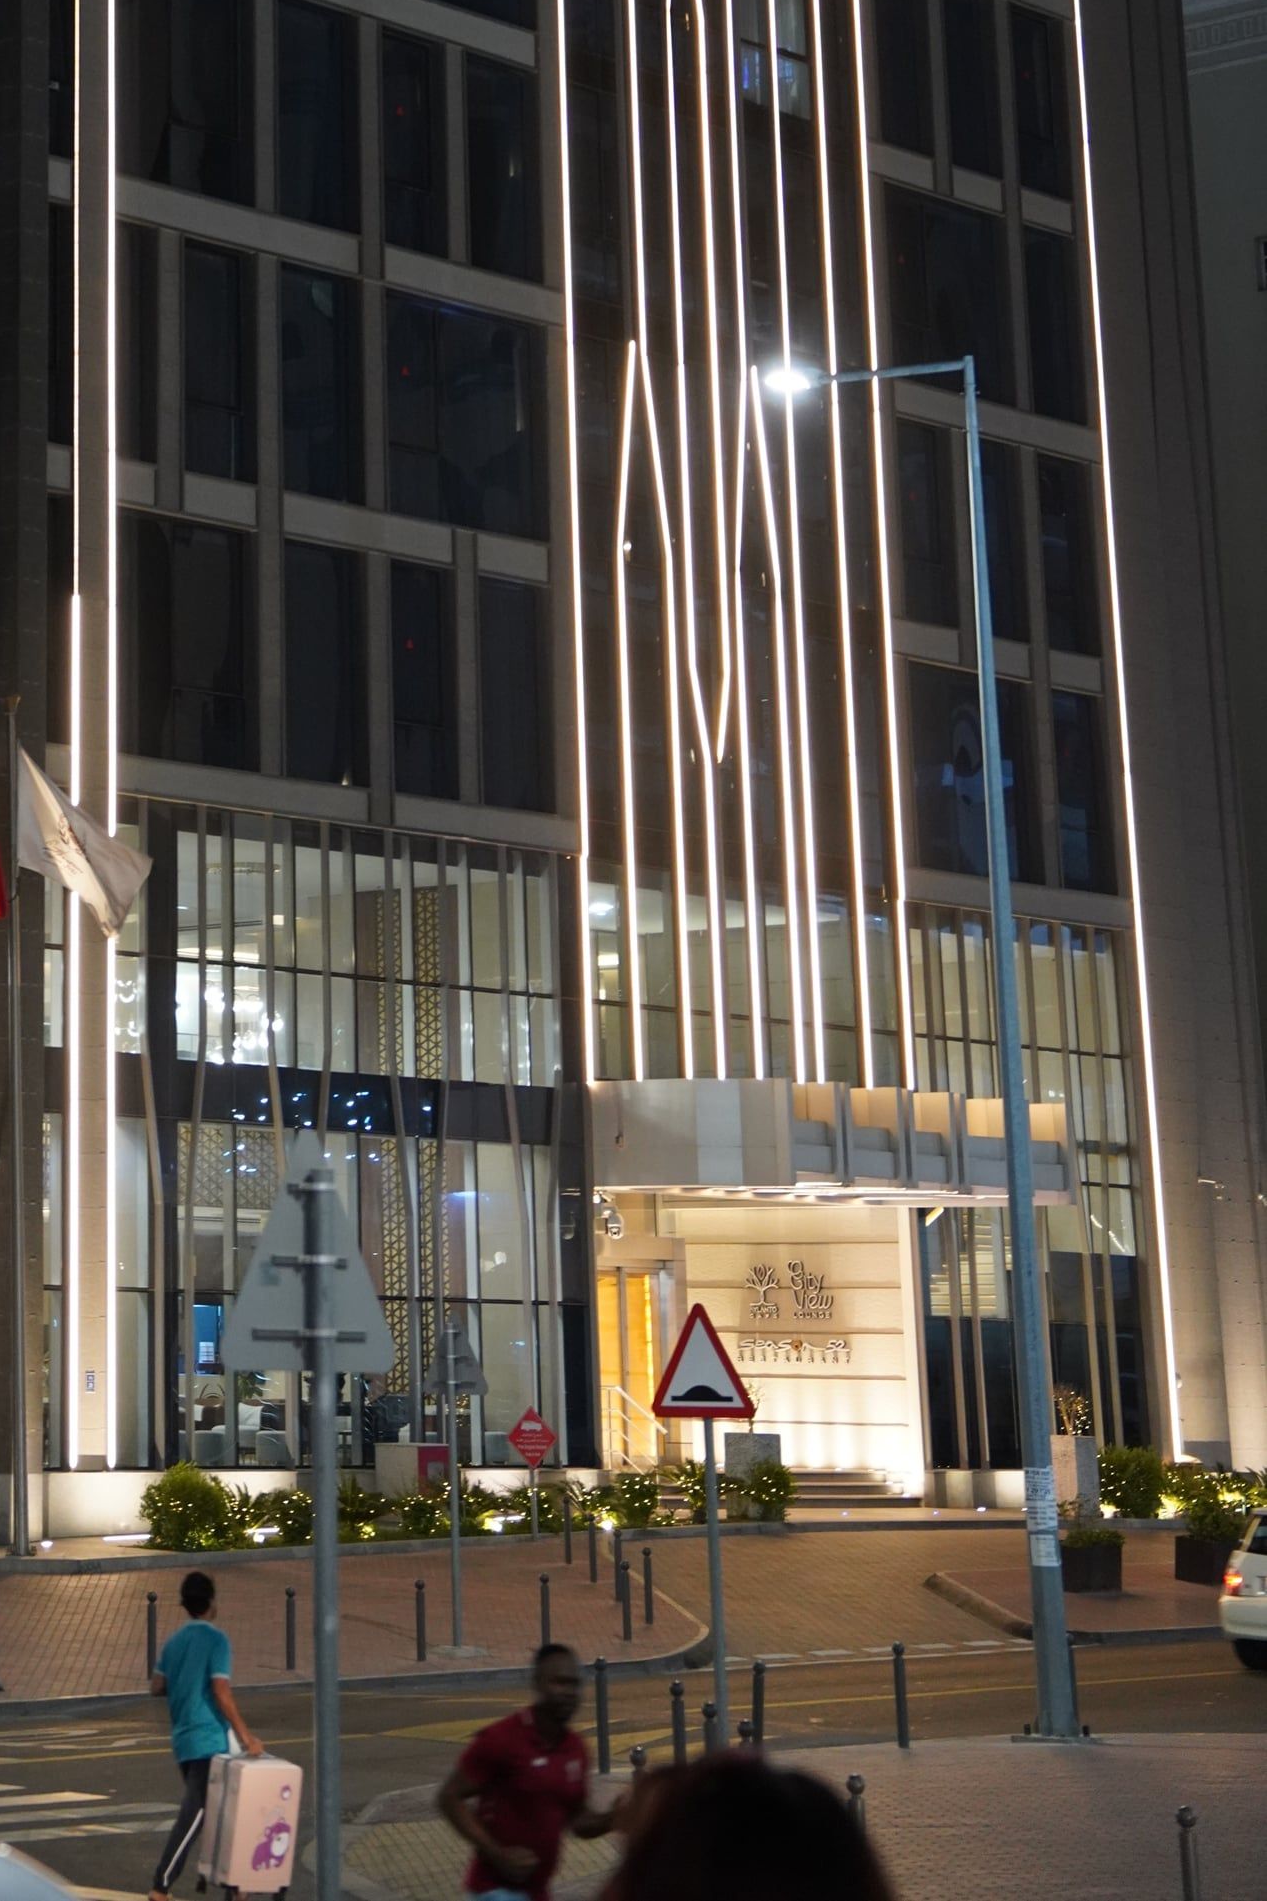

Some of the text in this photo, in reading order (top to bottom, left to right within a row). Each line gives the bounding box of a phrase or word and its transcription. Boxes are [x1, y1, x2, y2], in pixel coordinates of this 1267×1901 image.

[788, 1260, 824, 1294] City
[793, 1289, 833, 1309] View
[793, 1311, 832, 1319] LOUNGE
